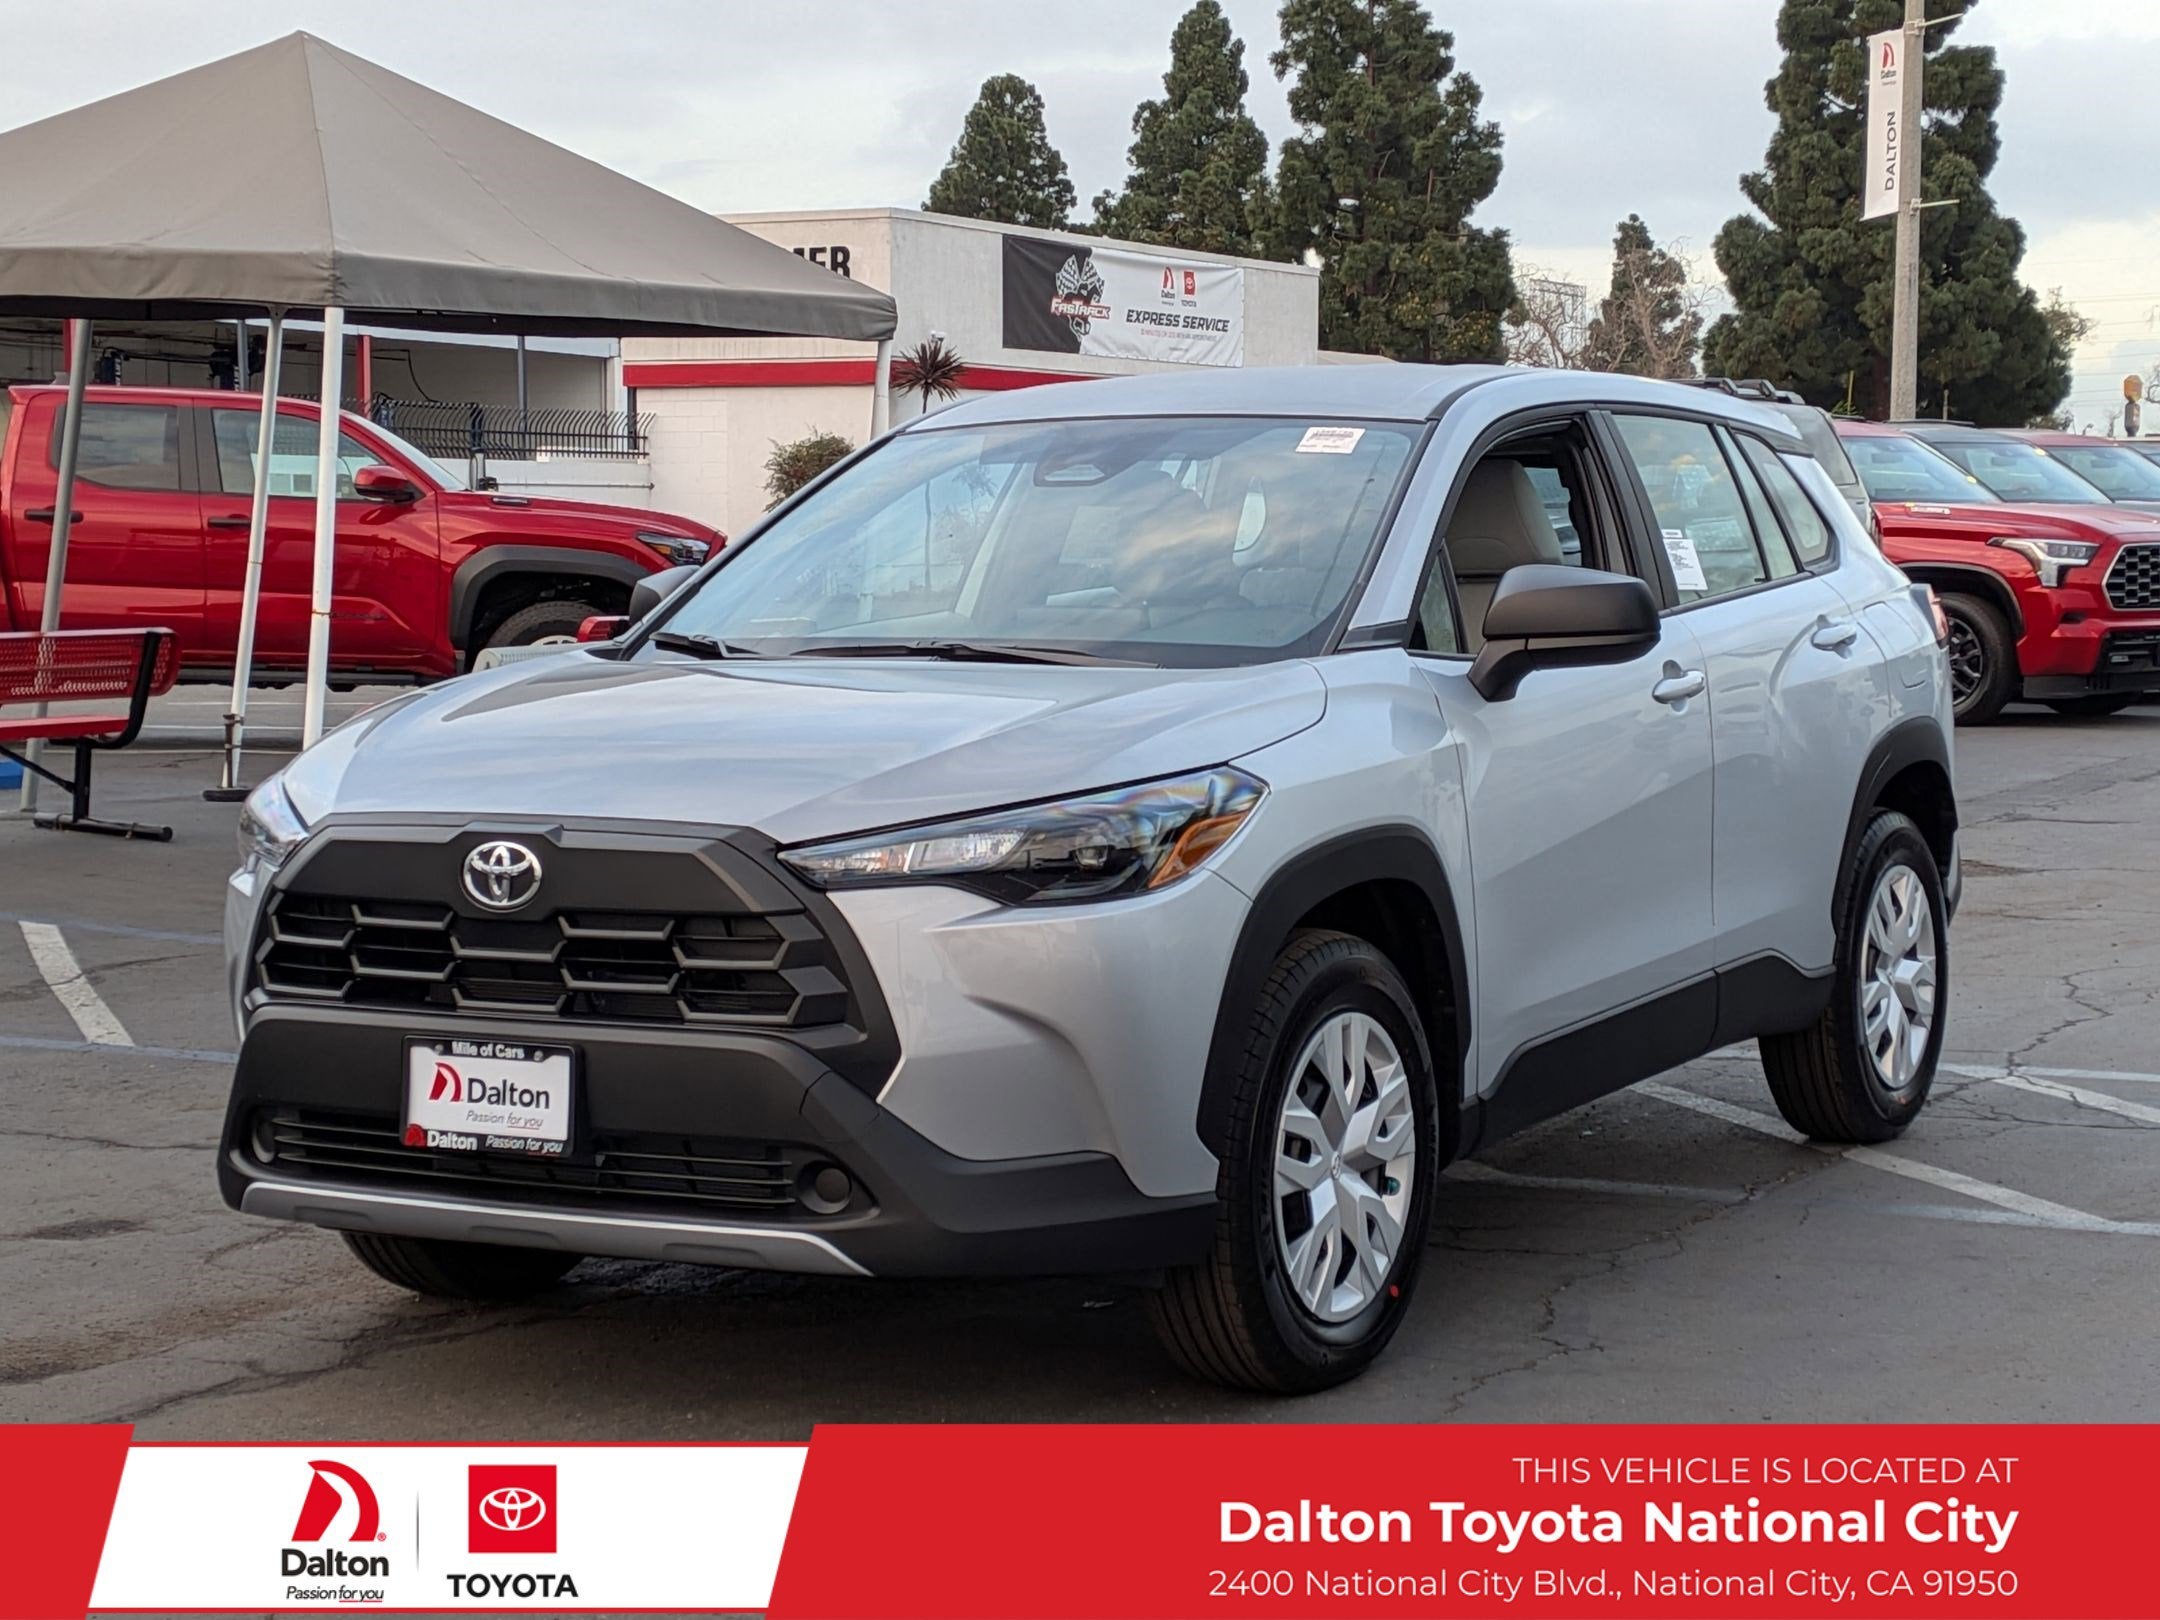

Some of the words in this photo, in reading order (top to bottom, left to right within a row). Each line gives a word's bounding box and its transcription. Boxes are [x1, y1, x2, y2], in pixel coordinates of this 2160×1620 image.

[1885, 112, 1896, 190] DALTON
[793, 246, 850, 278] ER
[1126, 309, 1180, 327] EXPRESS
[1182, 315, 1230, 332] SERVICE
[452, 1041, 478, 1056] Mile
[480, 1044, 494, 1057] of
[495, 1044, 525, 1059] Cars
[467, 1077, 550, 1109] Dalton
[466, 1110, 505, 1125] Passion
[507, 1112, 522, 1126] for
[524, 1117, 544, 1128] you
[427, 1131, 478, 1150] Dalton
[485, 1135, 525, 1150] Passion
[526, 1138, 541, 1151] for
[542, 1143, 564, 1153] you
